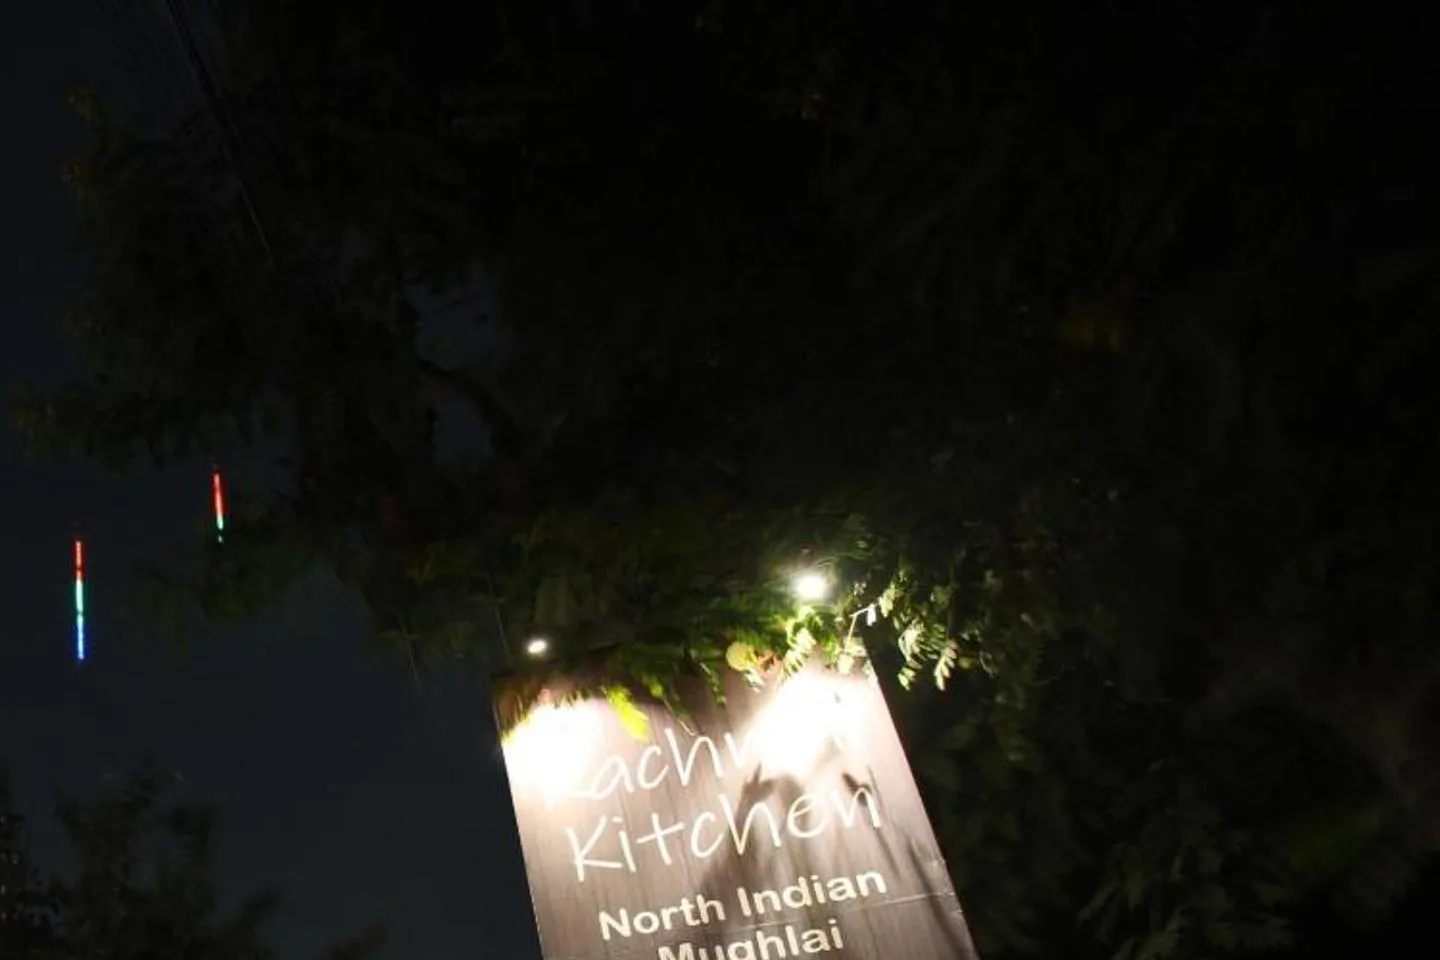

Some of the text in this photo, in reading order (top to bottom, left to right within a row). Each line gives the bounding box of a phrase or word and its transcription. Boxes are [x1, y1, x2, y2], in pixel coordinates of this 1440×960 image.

[566, 786, 882, 882] Kitchen
[598, 868, 887, 941] North Indian
